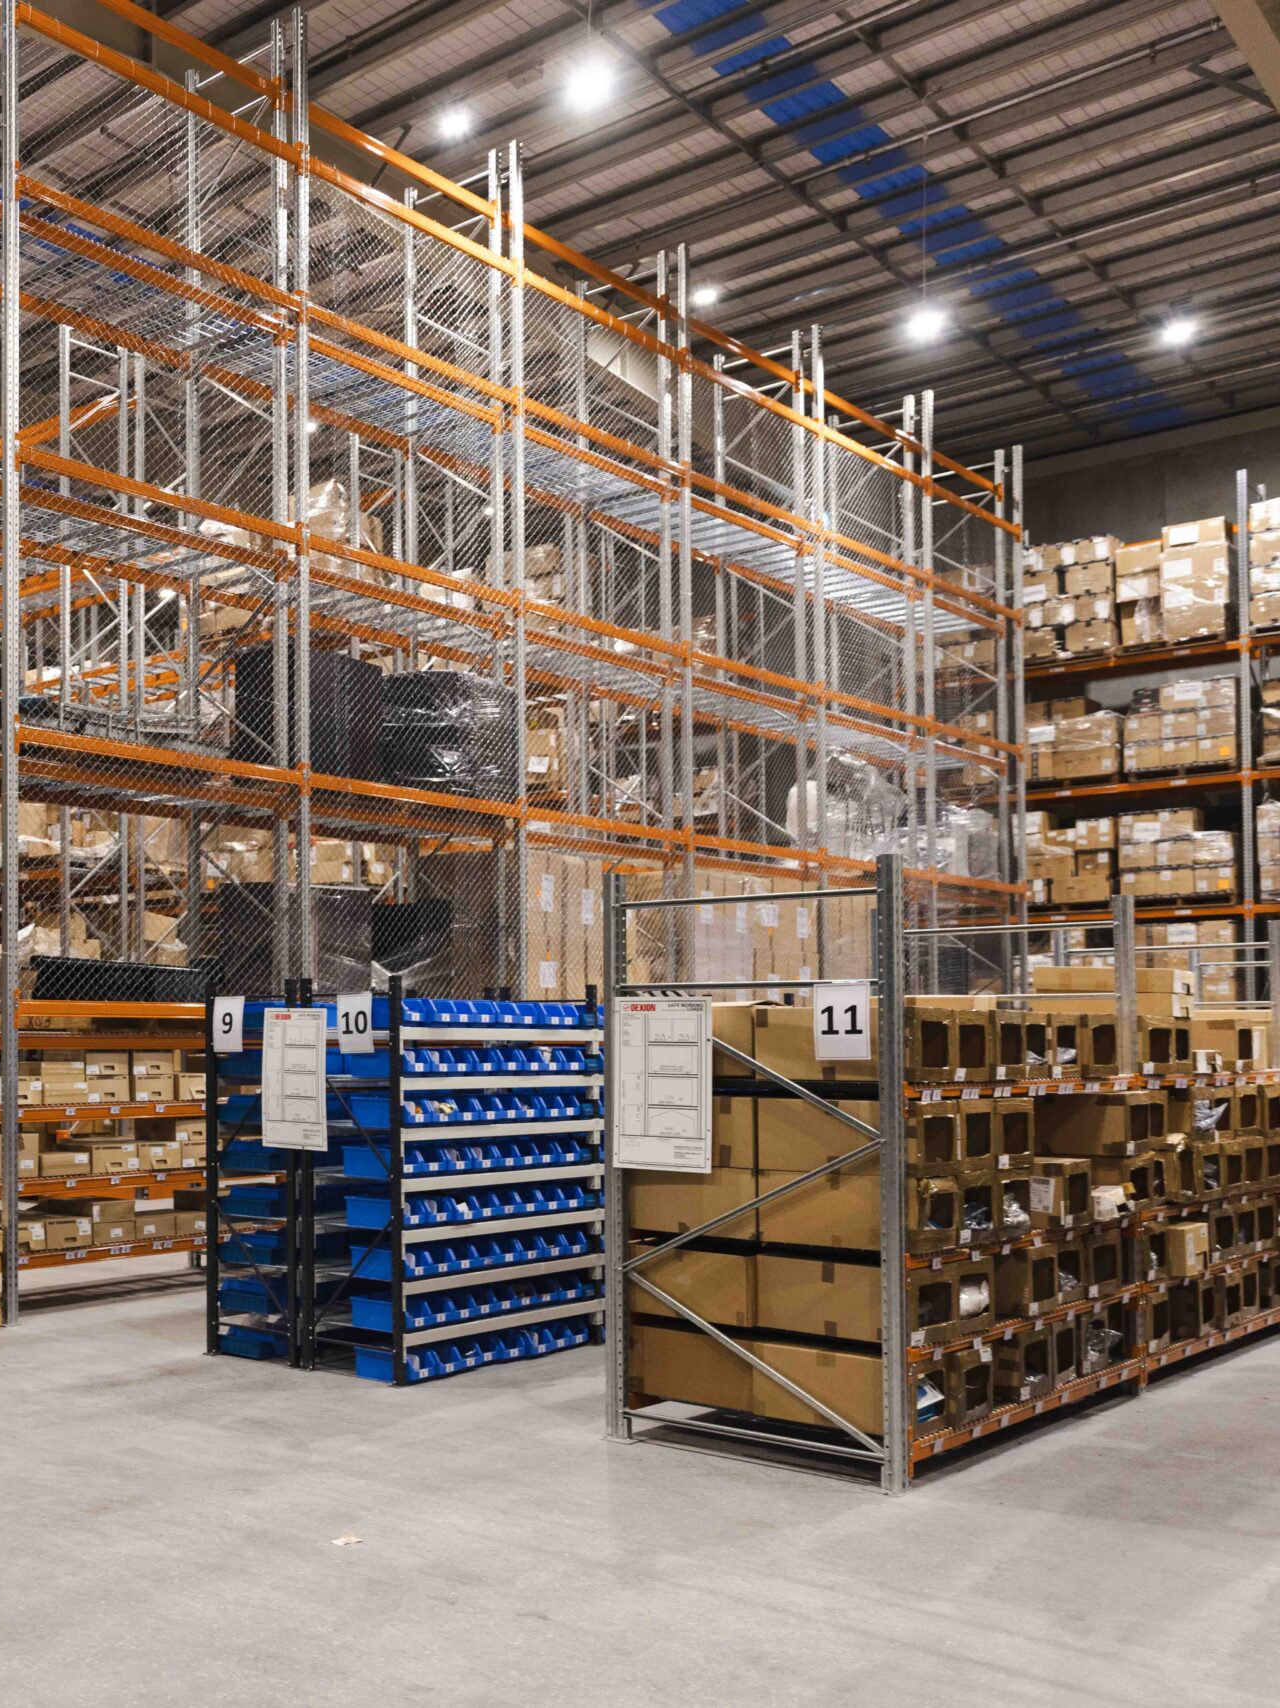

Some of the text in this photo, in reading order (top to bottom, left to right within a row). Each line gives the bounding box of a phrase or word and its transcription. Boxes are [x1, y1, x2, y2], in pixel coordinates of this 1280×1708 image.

[631, 1003, 657, 1012] DEXION
[222, 1012, 233, 1034] 9
[341, 1010, 368, 1035] 10
[820, 1004, 863, 1035] 11
